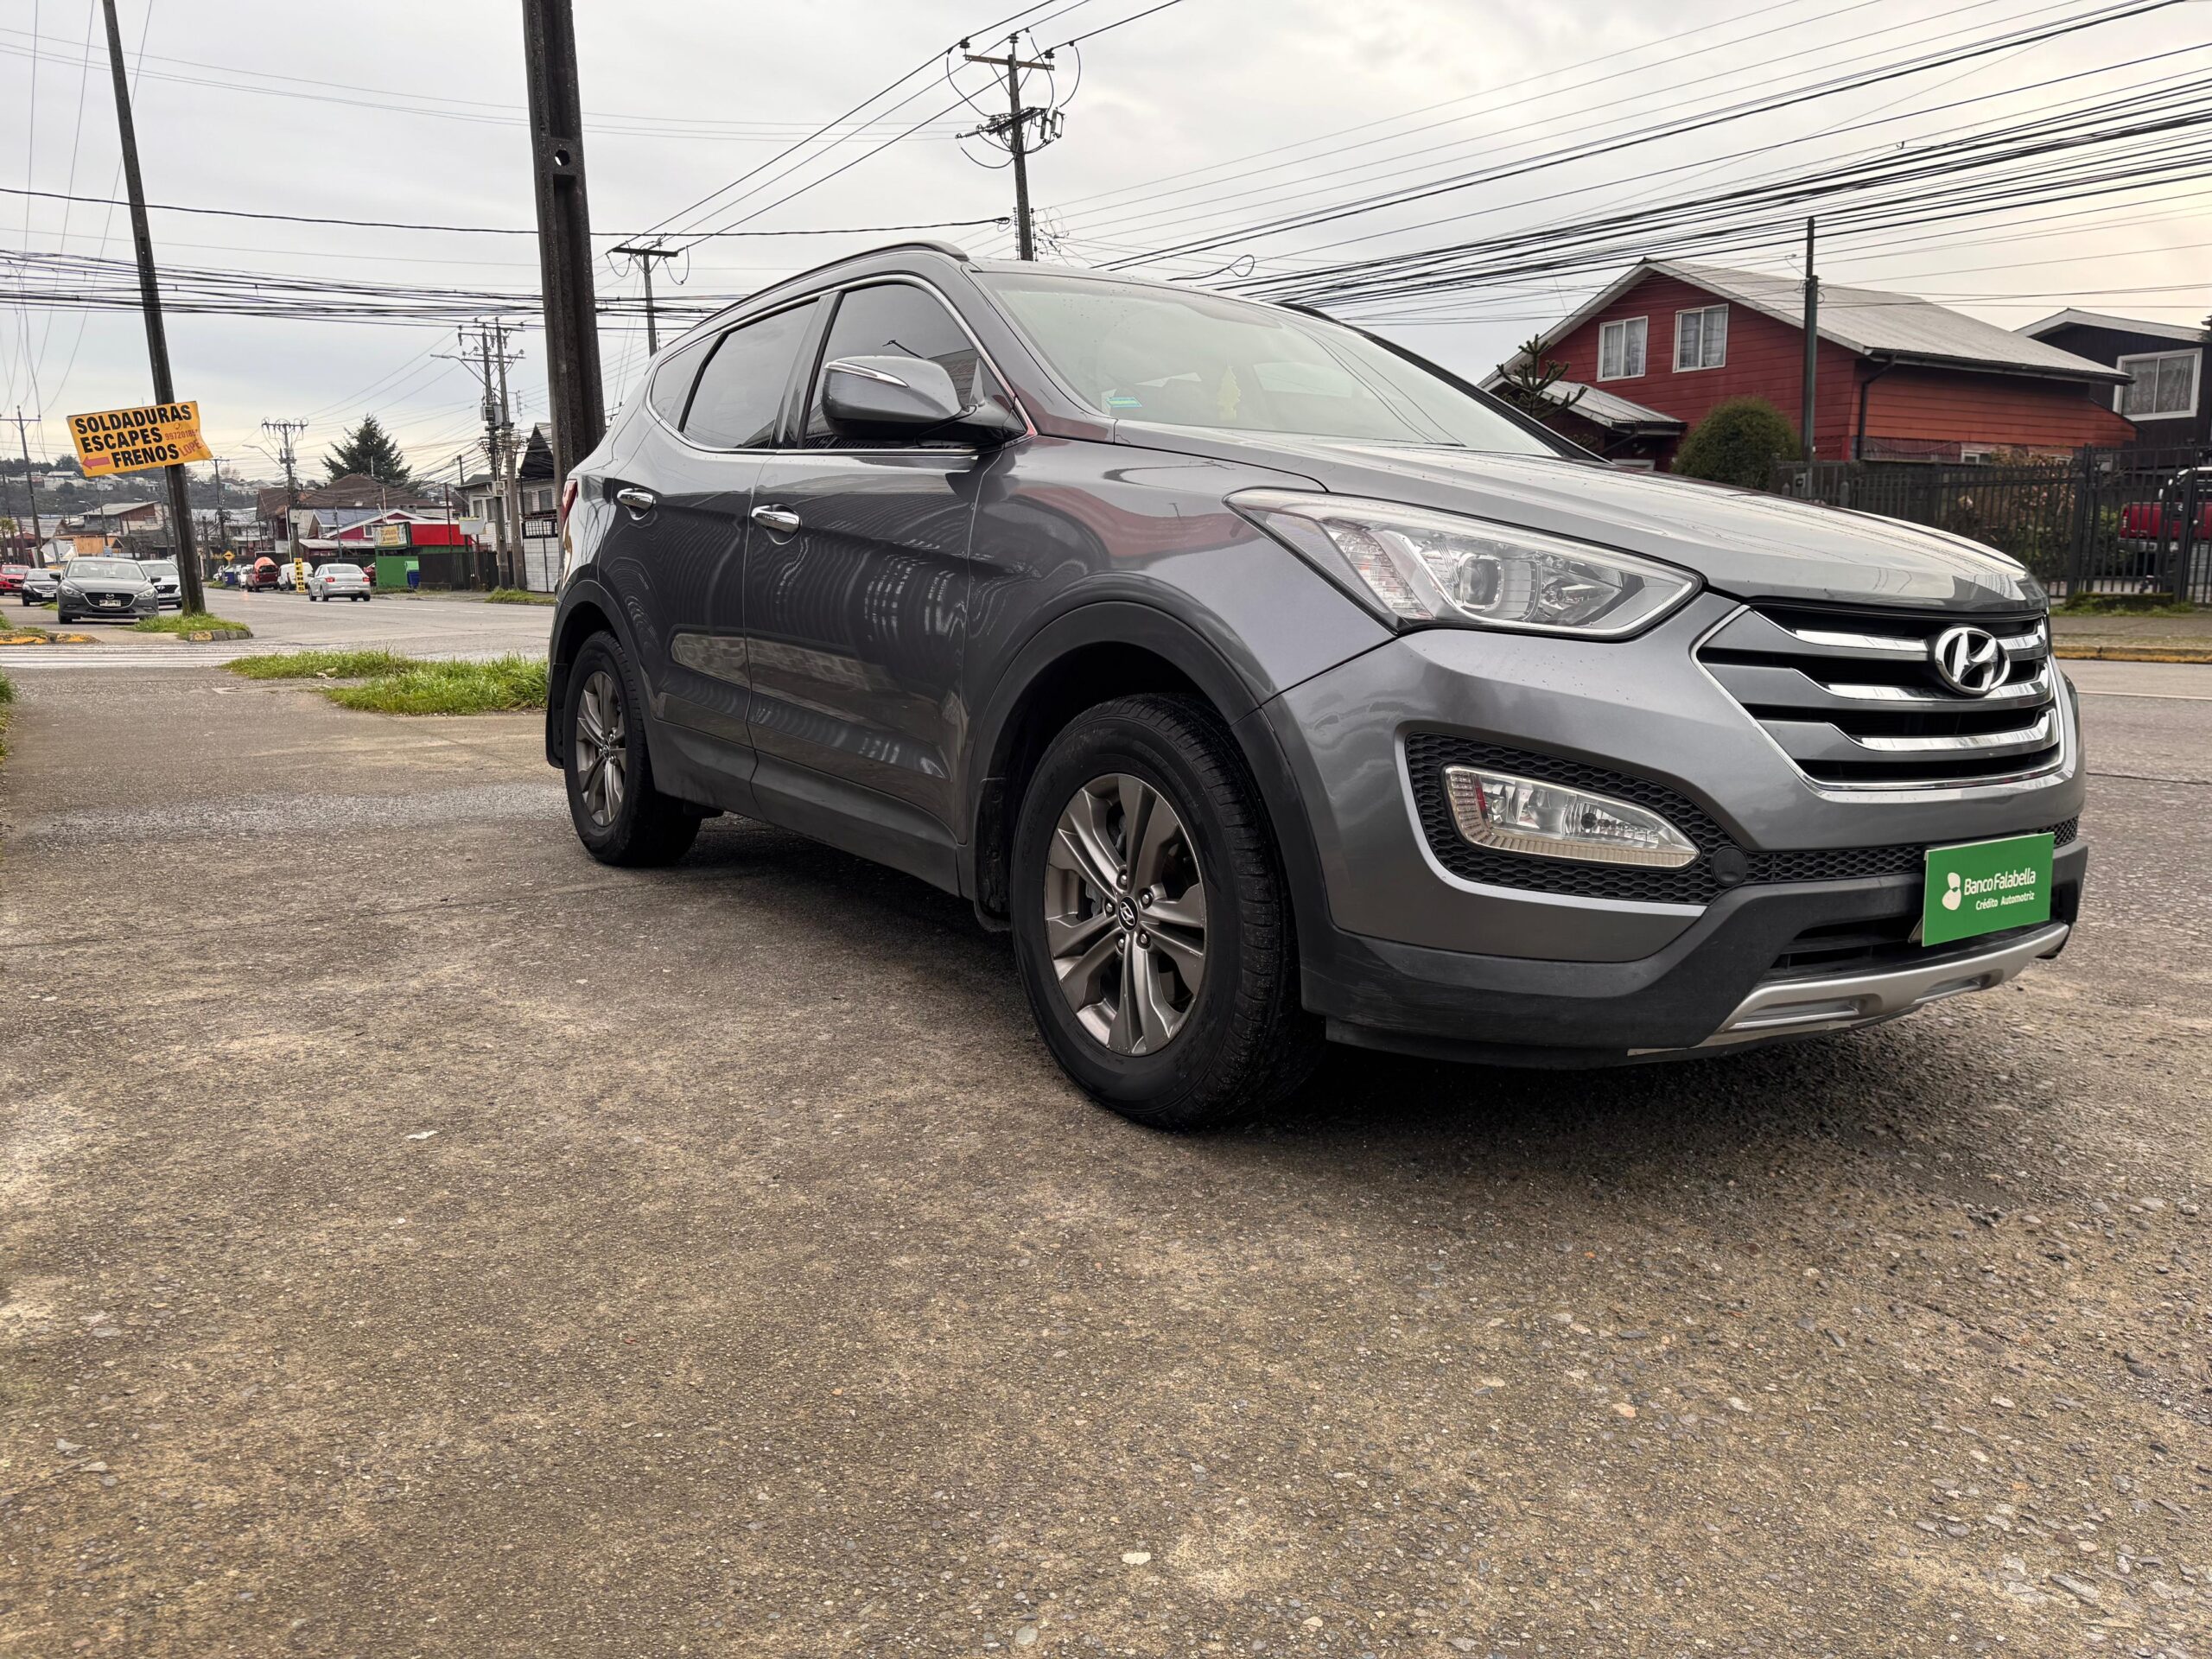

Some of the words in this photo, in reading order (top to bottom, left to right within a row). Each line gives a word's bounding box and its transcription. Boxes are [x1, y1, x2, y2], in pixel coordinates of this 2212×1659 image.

[74, 404, 192, 435] SOLDADURAS
[80, 427, 163, 454] ESCAPES
[178, 439, 204, 457] LOPE
[111, 443, 180, 468] FRENOS
[1975, 898, 1999, 911] Crédito
[2000, 890, 2035, 906] Automotriz
